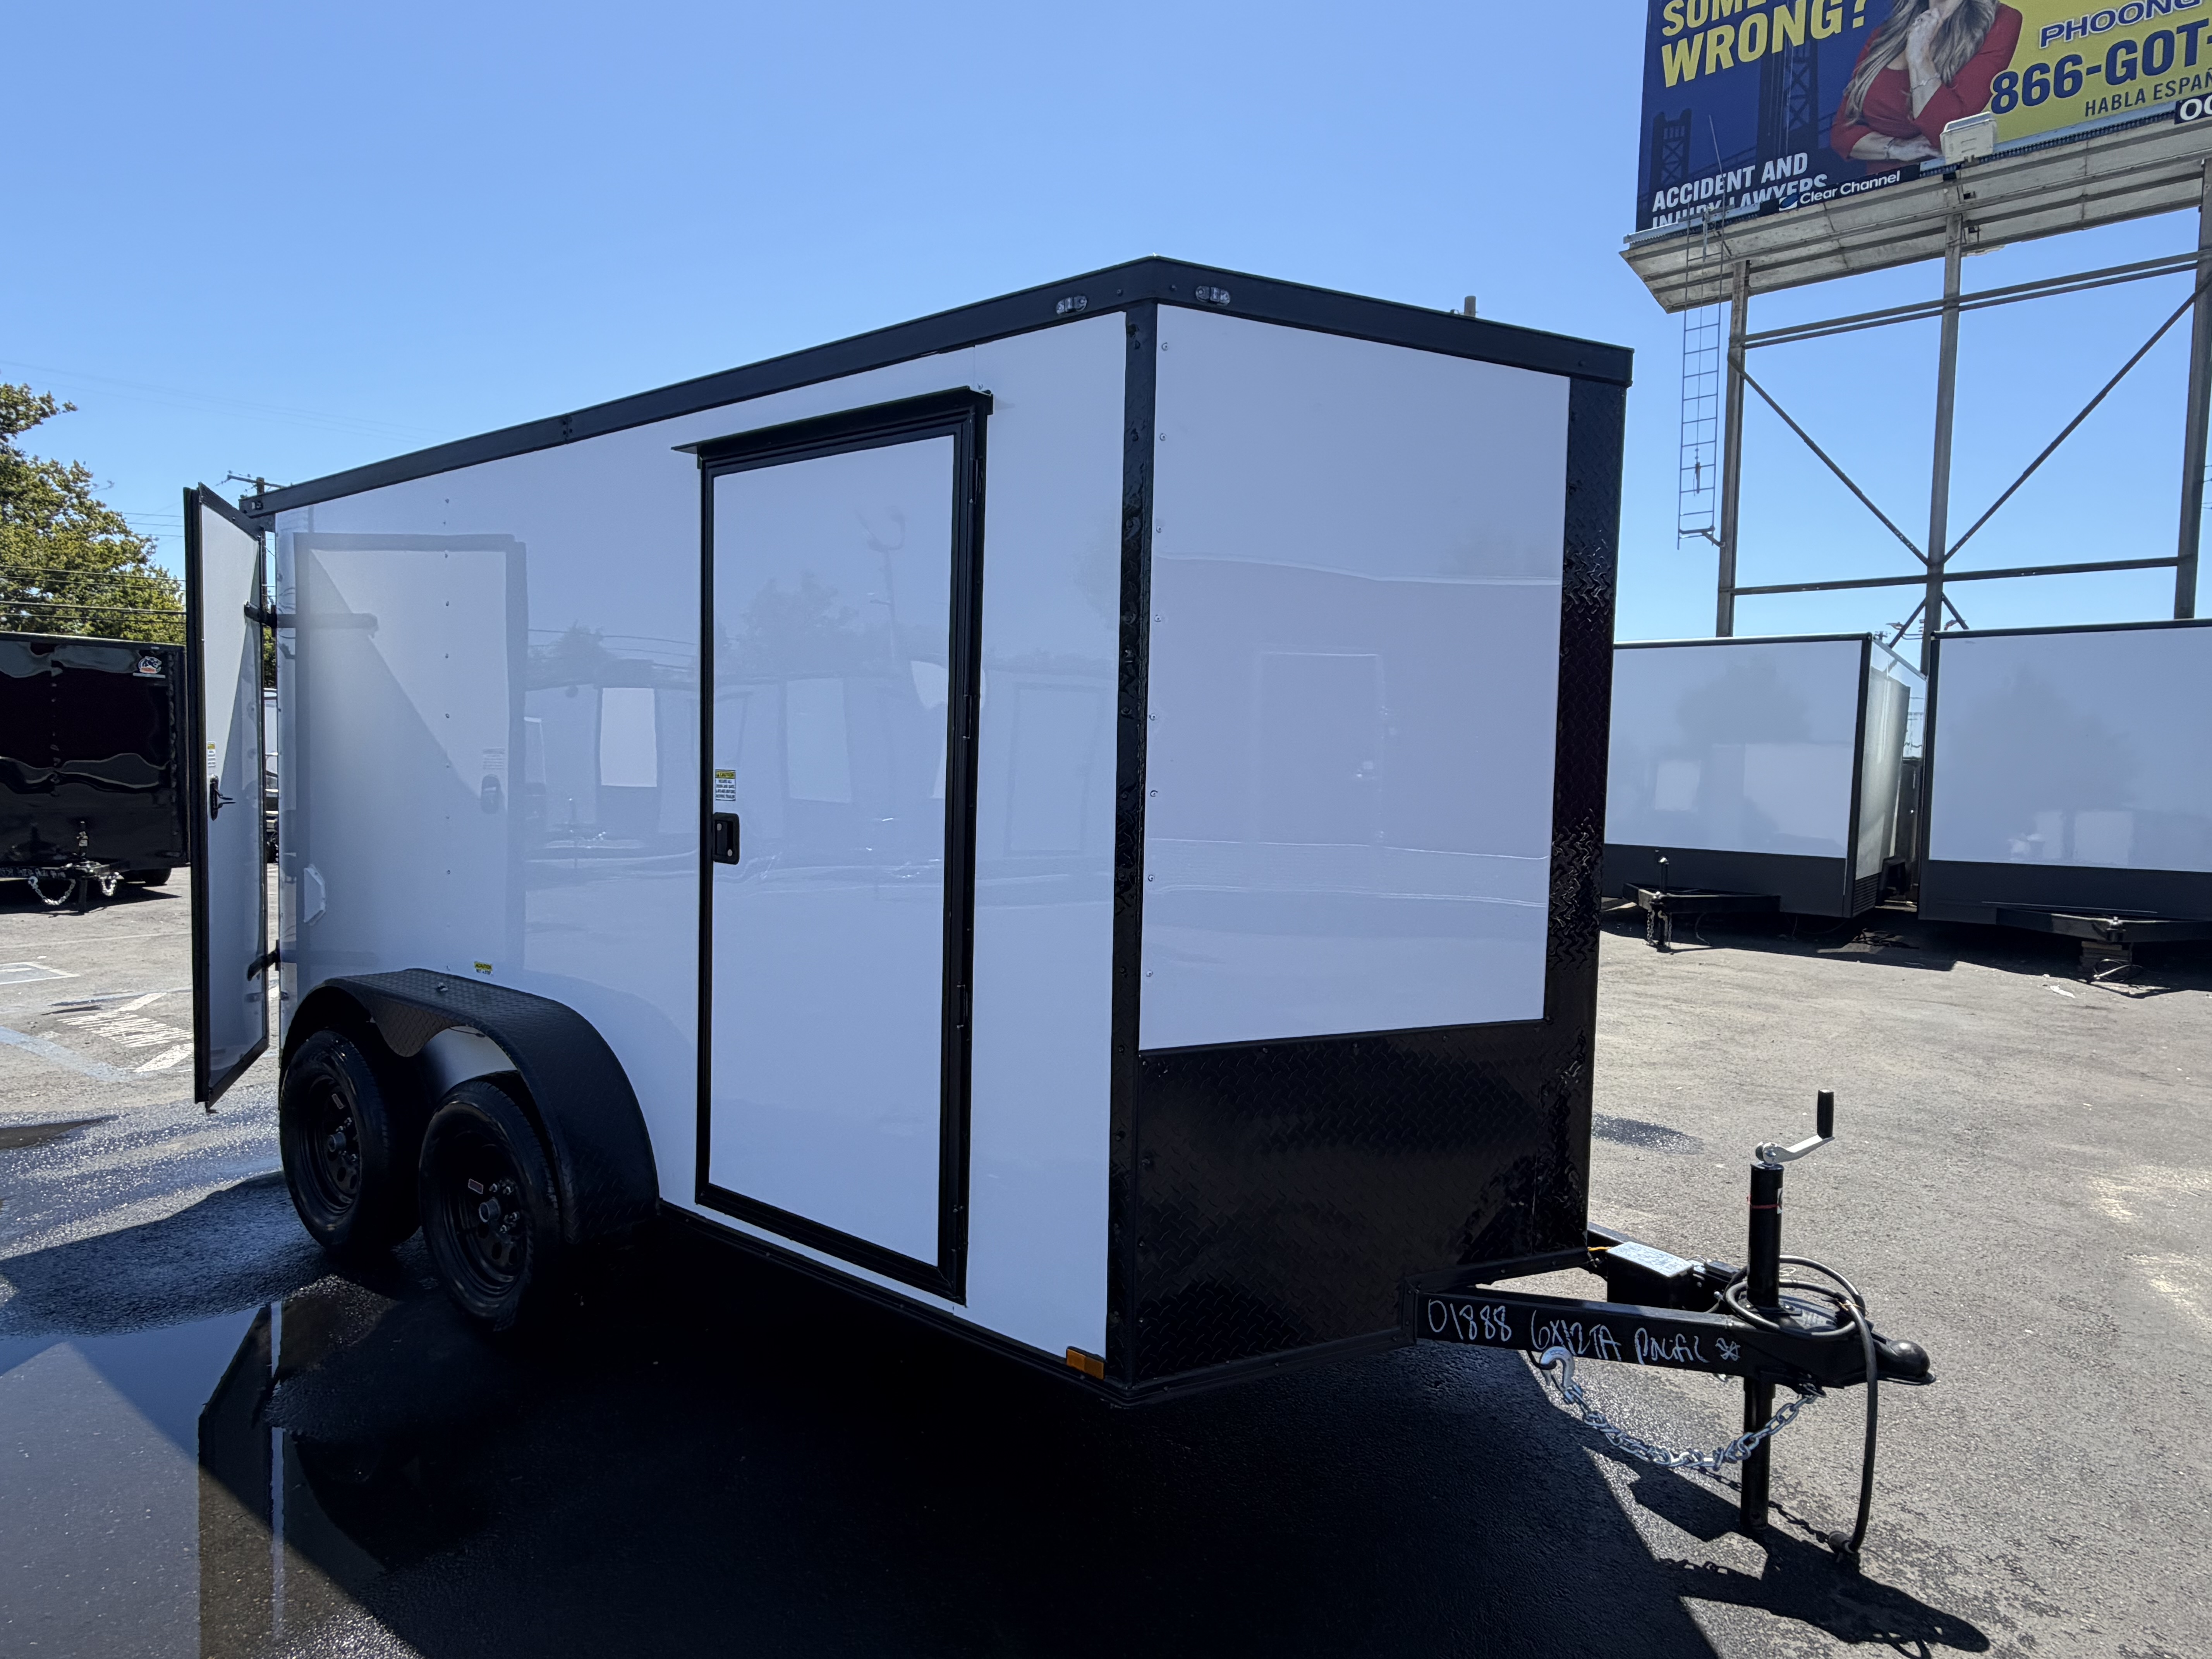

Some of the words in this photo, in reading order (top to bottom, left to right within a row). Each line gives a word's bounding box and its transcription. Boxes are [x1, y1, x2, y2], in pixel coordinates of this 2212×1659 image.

[1662, 0, 1767, 36] SOM
[1661, 0, 1867, 88] WRONG?
[2085, 88, 2145, 117] HABLA
[1652, 165, 1755, 212] ACCIDENT
[1760, 153, 1808, 184] AND
[1800, 187, 1838, 204] Clear
[1840, 170, 1901, 195] Channel
[1428, 1299, 1512, 1341] 01888
